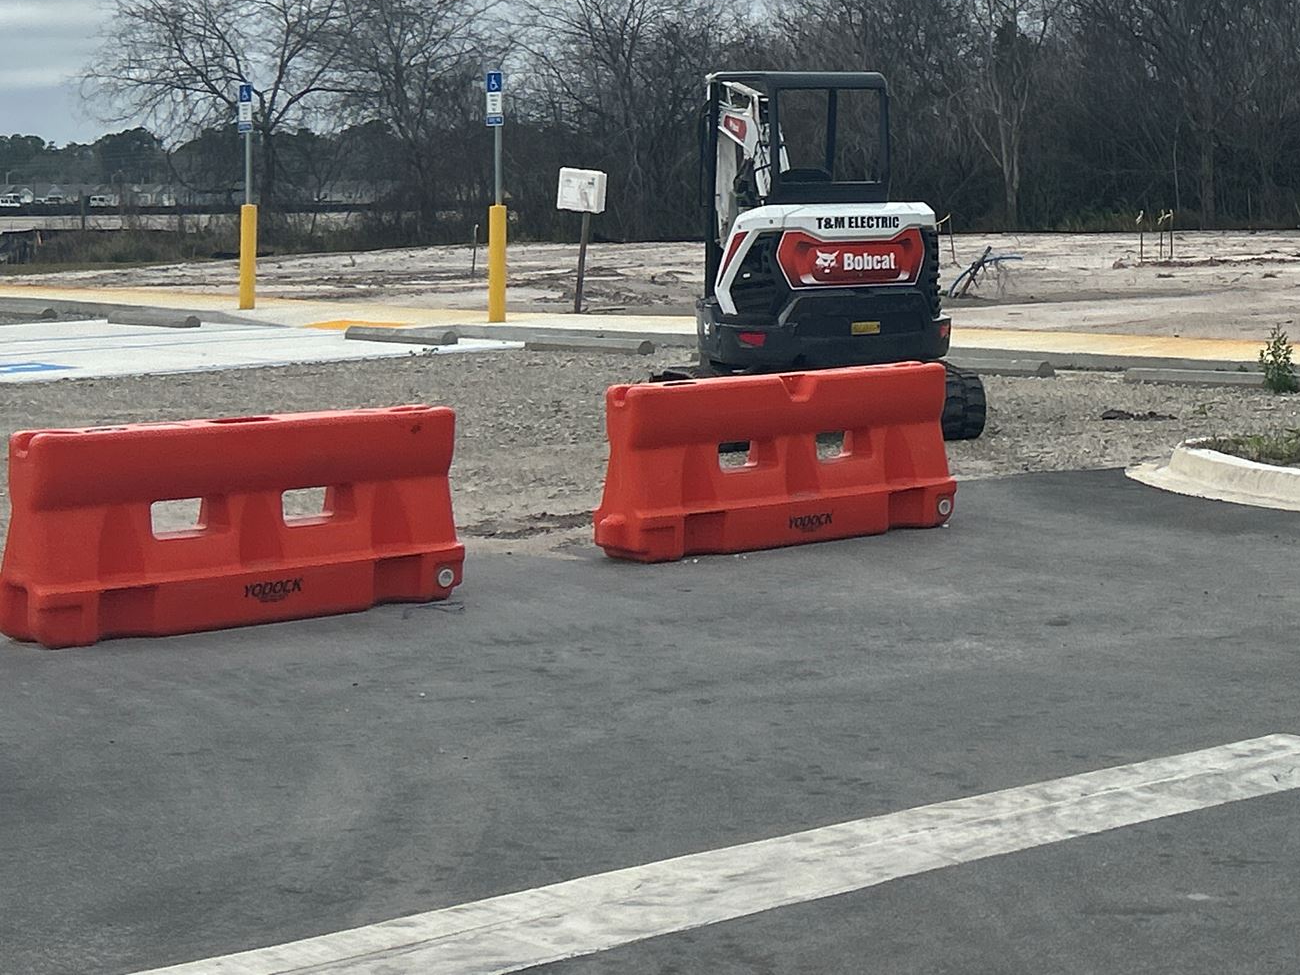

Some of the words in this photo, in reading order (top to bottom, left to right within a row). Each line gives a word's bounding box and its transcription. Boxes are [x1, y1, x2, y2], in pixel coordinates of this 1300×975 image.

[816, 216, 845, 229] T&M
[848, 216, 900, 229] ELECTRIC
[843, 252, 896, 271] Bobcat
[244, 577, 303, 598] YODOCK
